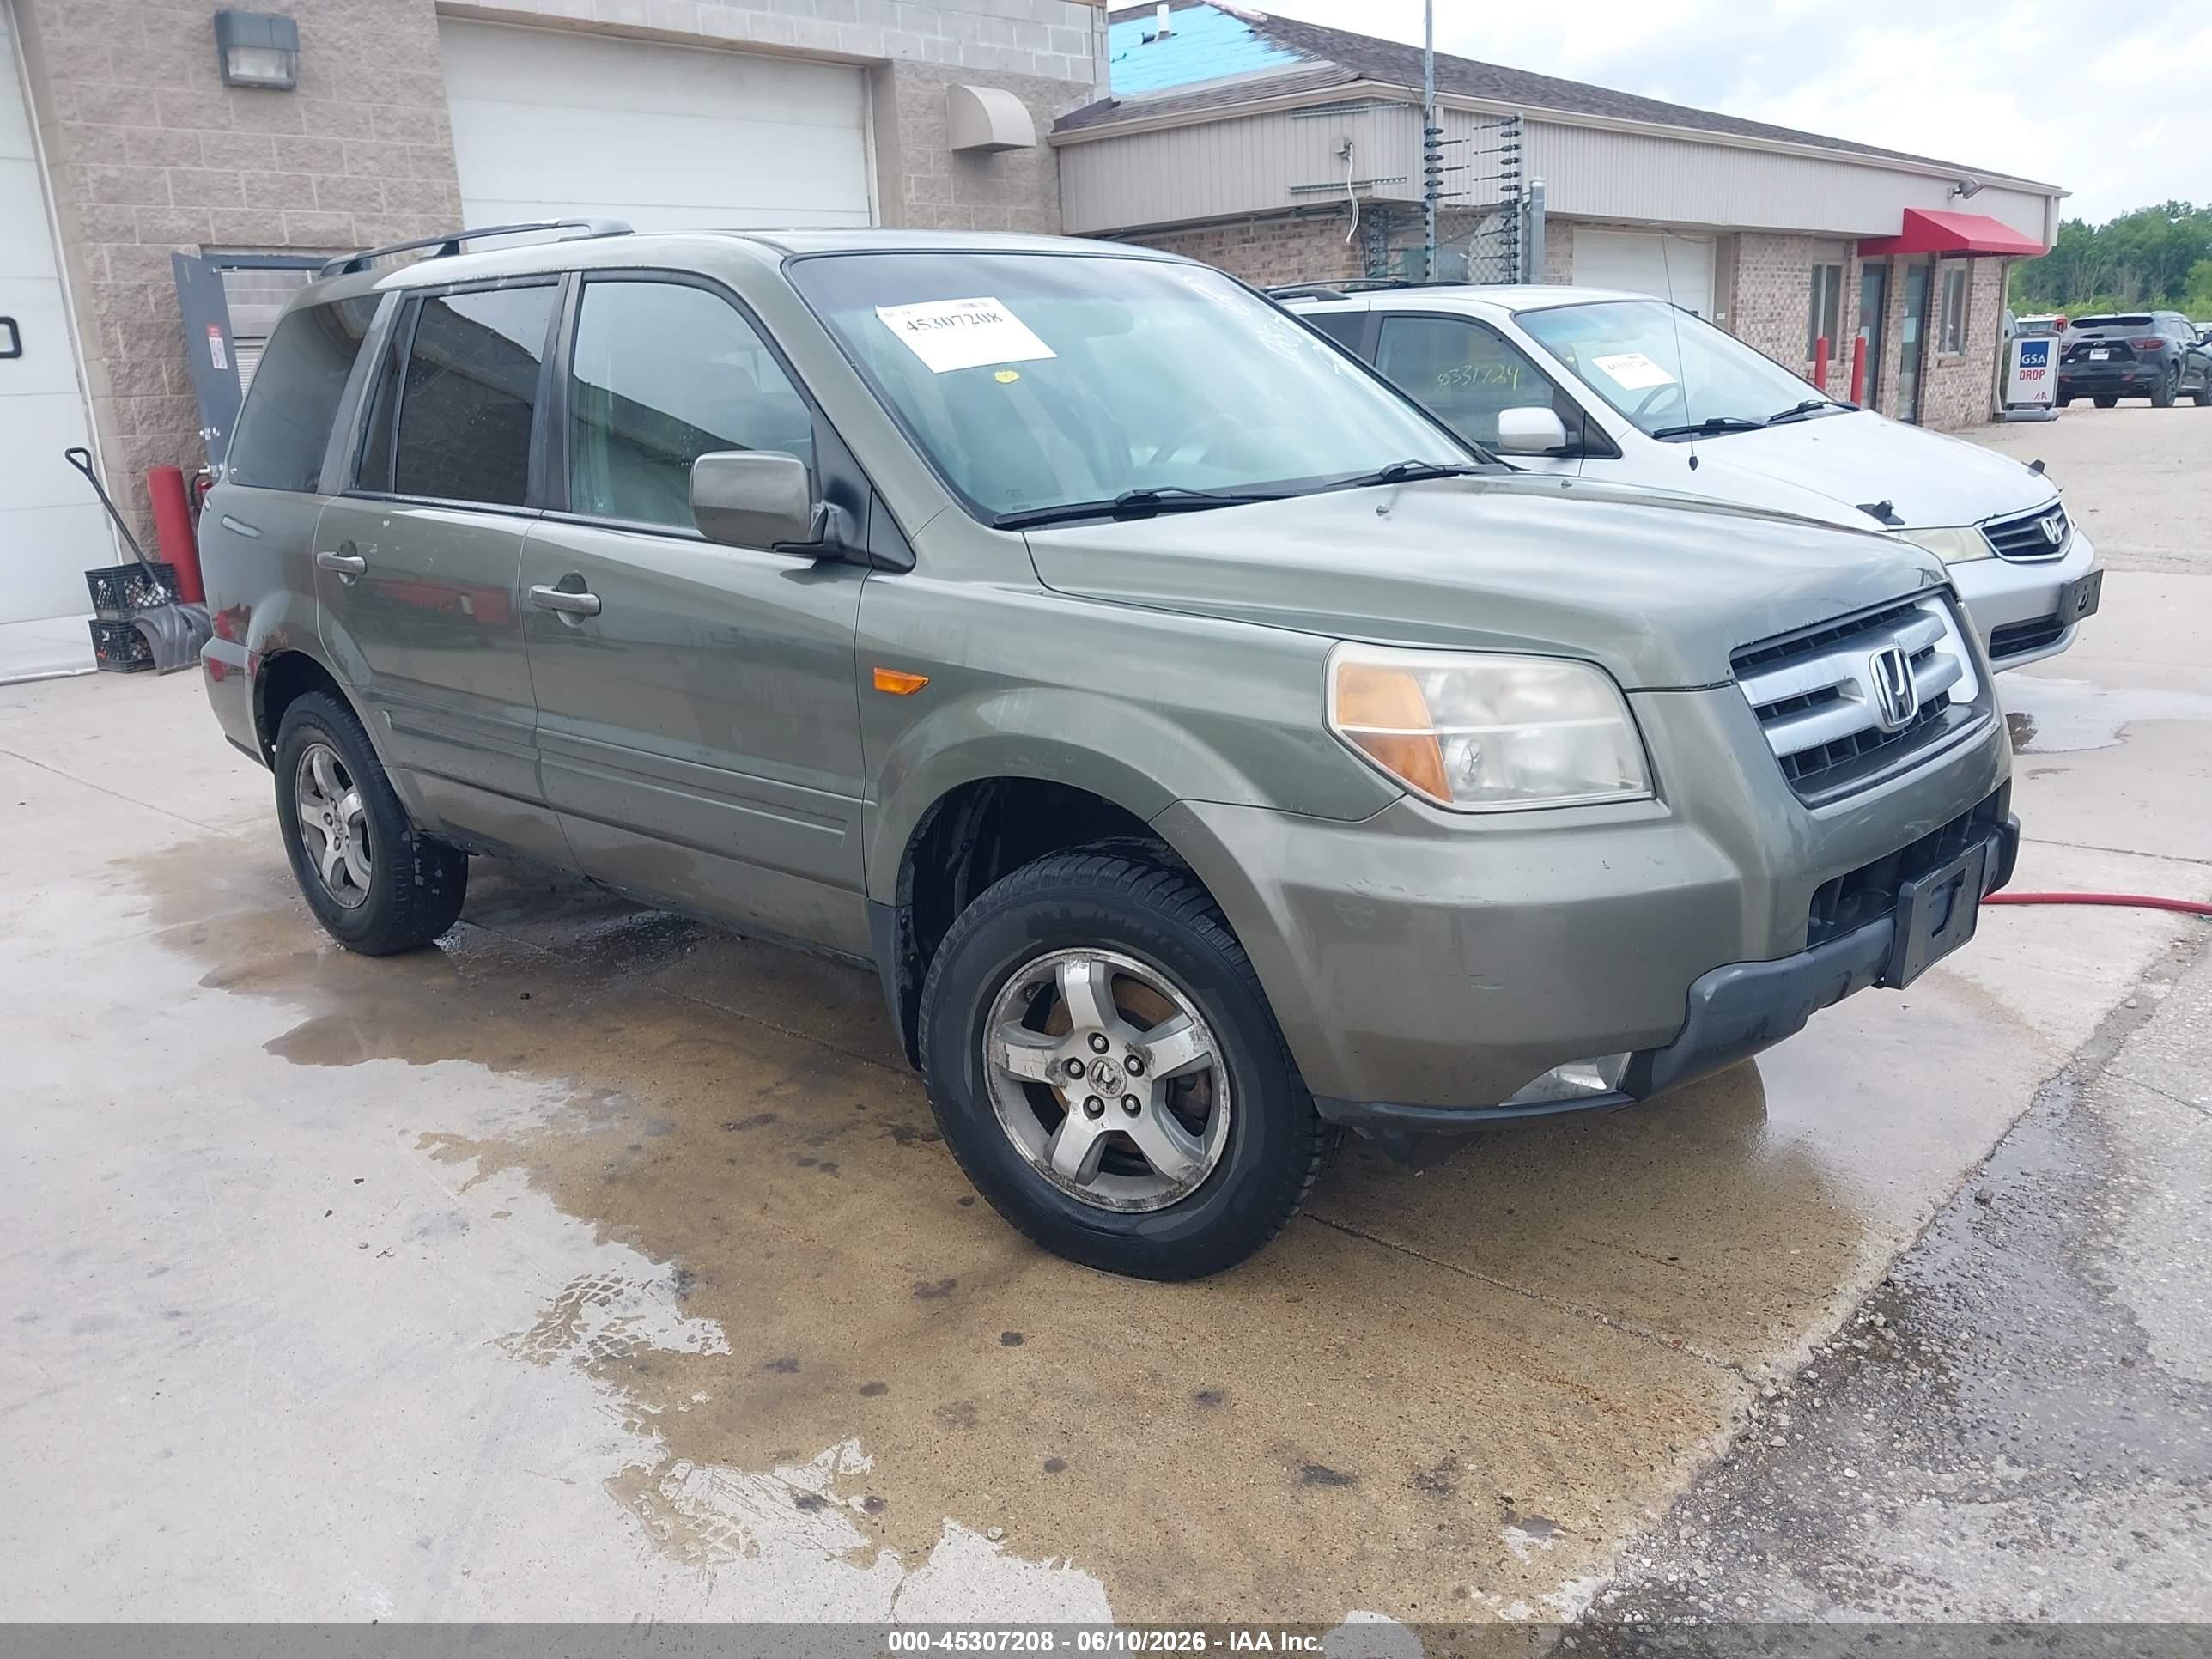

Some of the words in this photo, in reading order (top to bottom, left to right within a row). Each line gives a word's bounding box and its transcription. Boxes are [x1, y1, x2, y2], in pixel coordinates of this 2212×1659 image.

[906, 312, 1004, 332] 45307208
[2021, 353, 2046, 365] GSA
[2019, 369, 2046, 380] DROP
